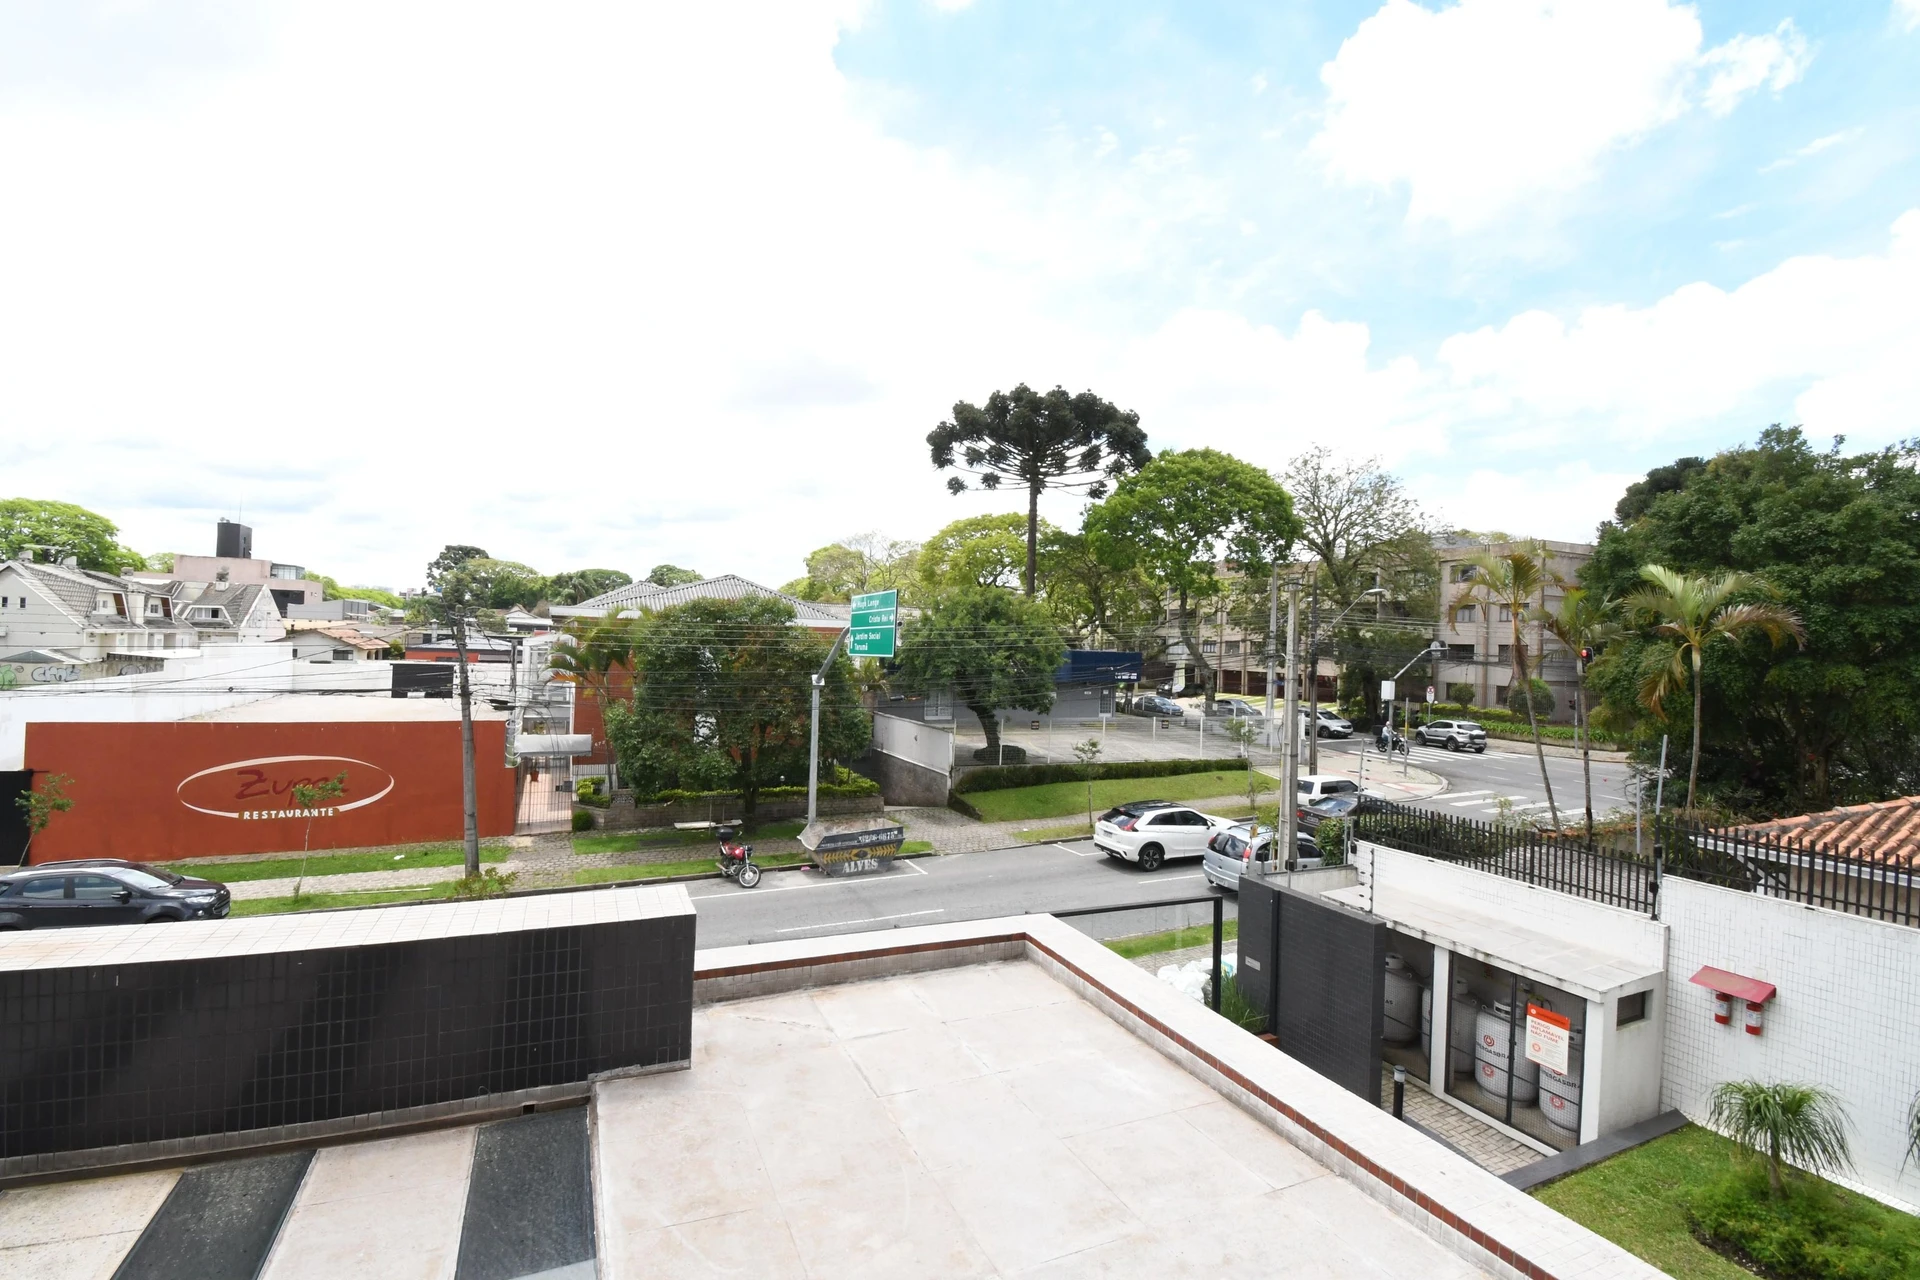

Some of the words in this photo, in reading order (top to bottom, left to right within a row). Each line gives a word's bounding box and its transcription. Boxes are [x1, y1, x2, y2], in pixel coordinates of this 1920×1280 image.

[869, 615, 880, 623] Cristo
[869, 632, 880, 640] Social
[243, 808, 335, 820] RESTAURANTE
[843, 859, 878, 873] ALVES
[1530, 1019, 1550, 1030] PERIGO
